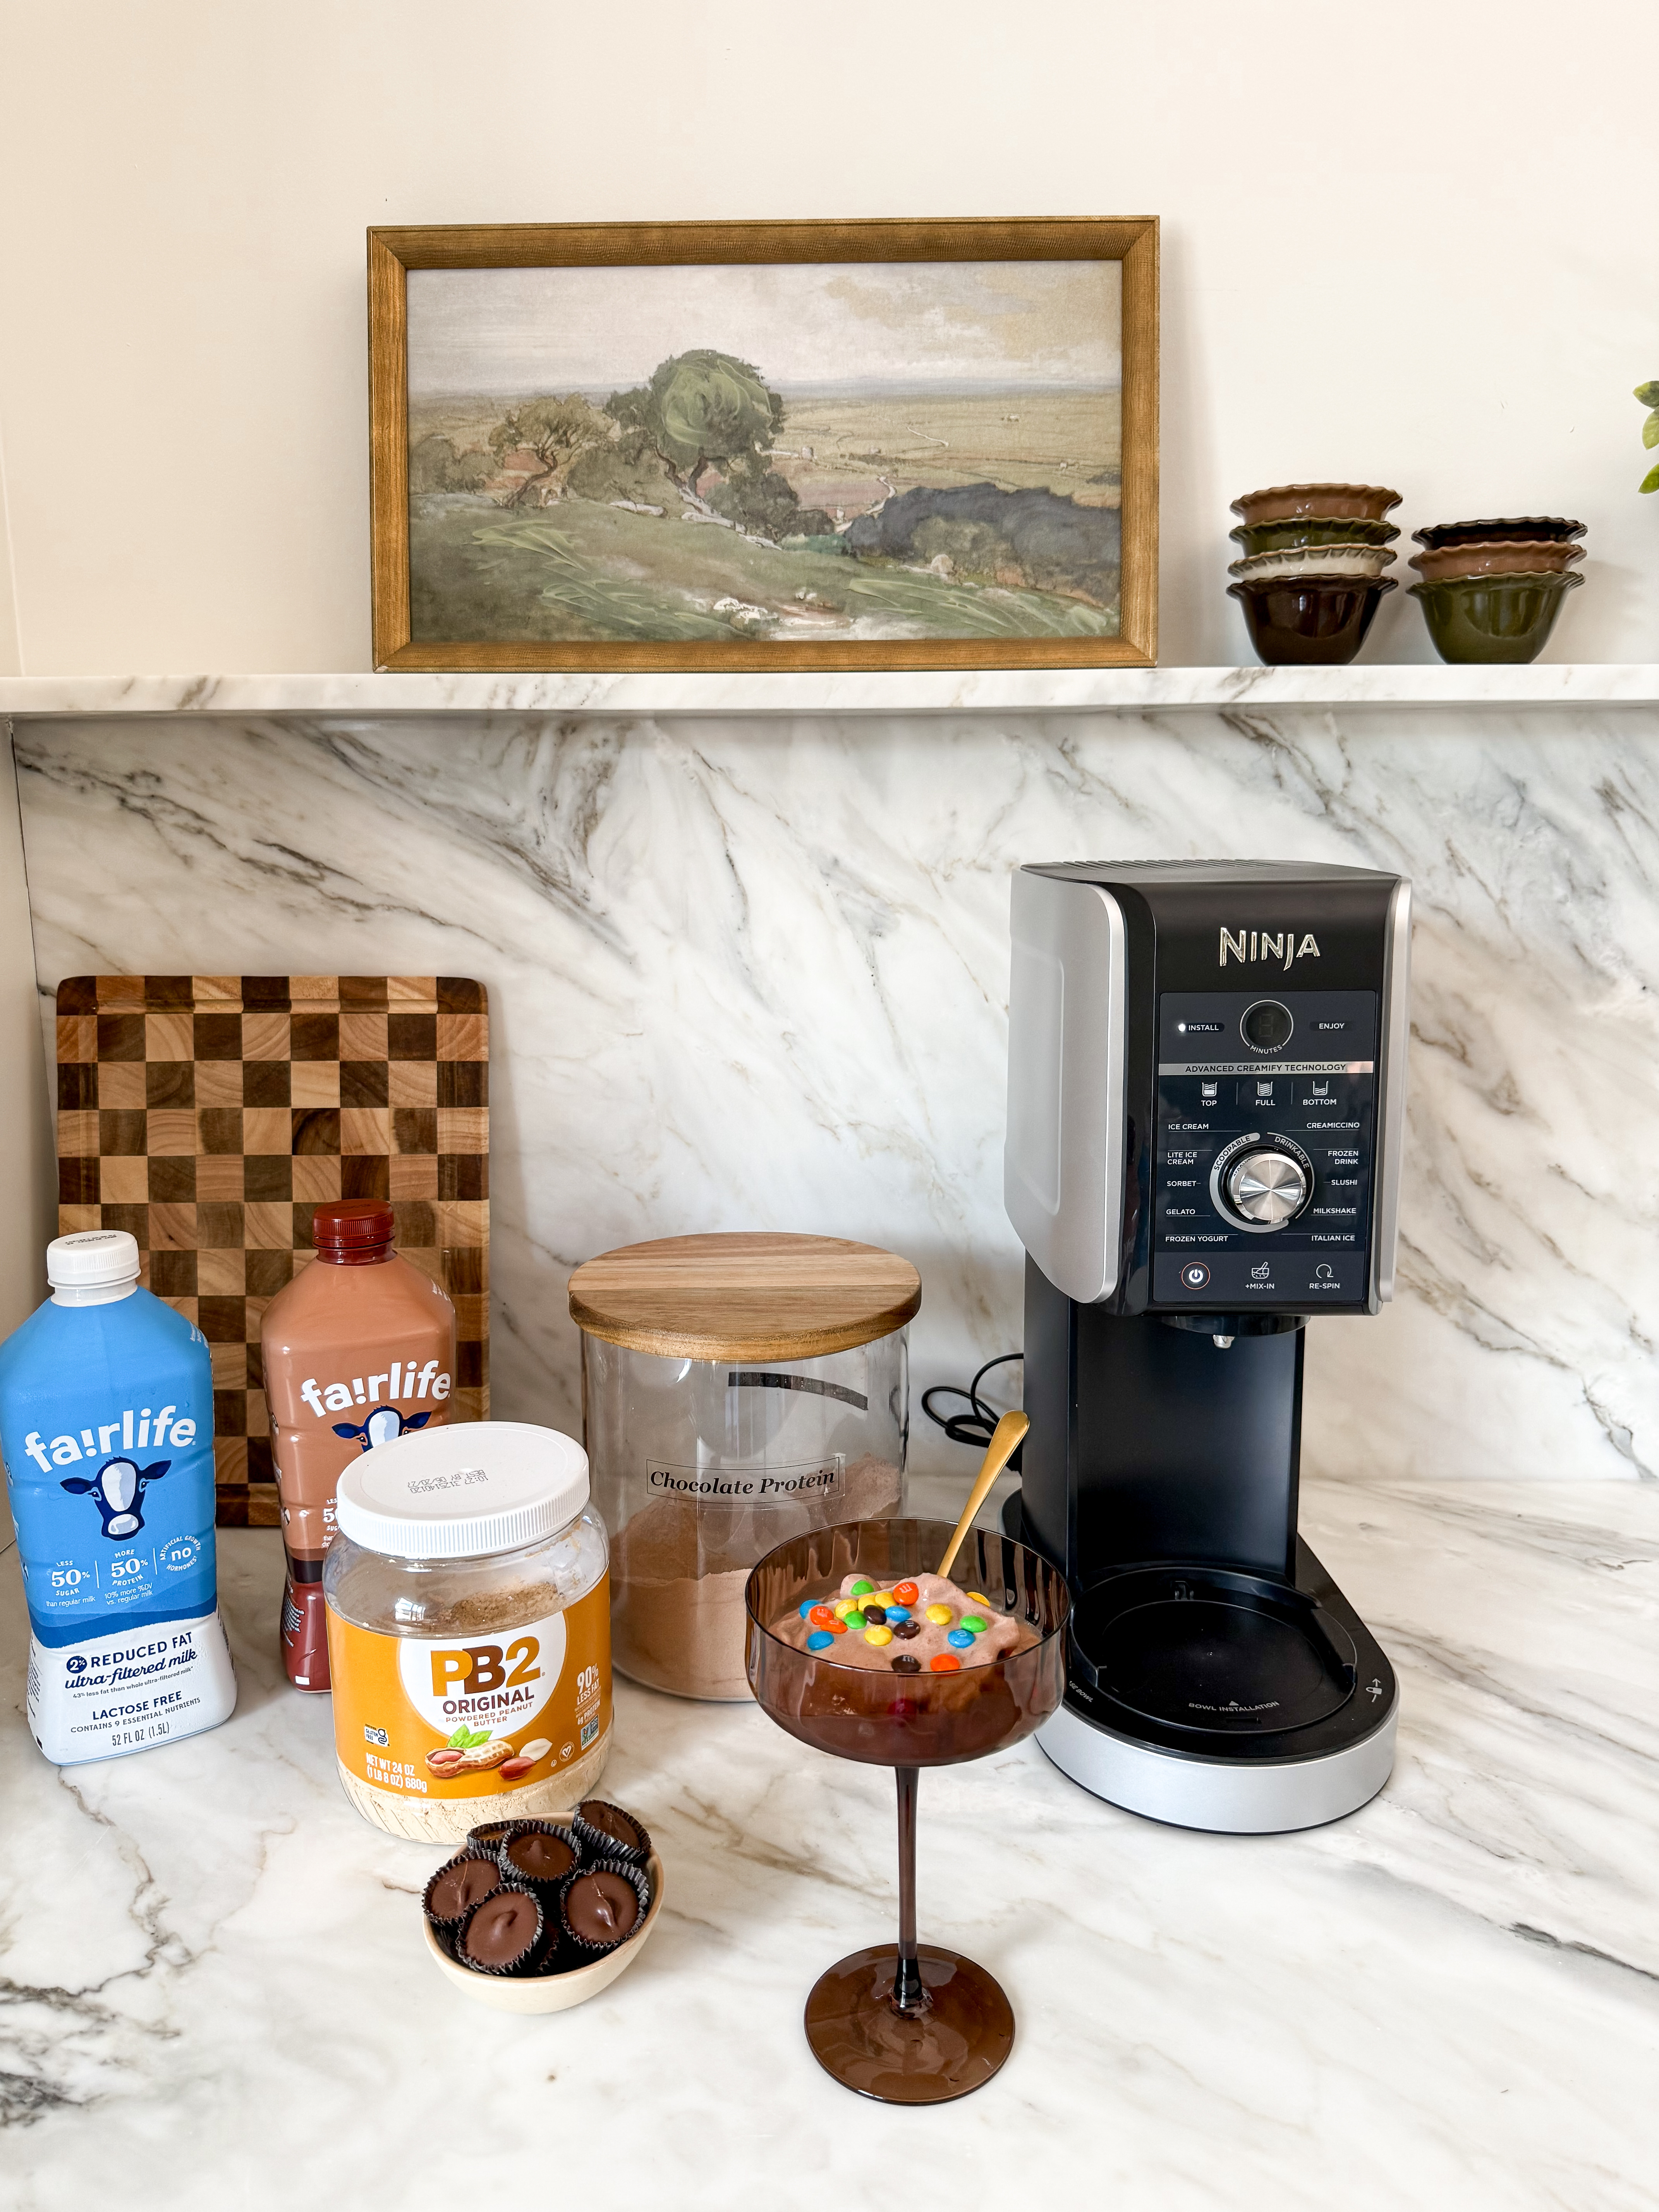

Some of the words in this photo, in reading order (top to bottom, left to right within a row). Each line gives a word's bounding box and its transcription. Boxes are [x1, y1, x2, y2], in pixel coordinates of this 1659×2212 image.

[1220, 927, 1320, 970] NINJA
[1250, 1045, 1282, 1054] MINUTES
[1285, 1063, 1346, 1072] TECHNOLOGY
[1214, 1135, 1251, 1171] SCOOPABLE
[1274, 1136, 1310, 1169] DRINKABLE
[408, 1476, 447, 1488] 06/20/27
[466, 1470, 486, 1478] BEST
[650, 1470, 754, 1494] Chocolate
[758, 1469, 835, 1494] Protein
[115, 1549, 135, 1558] MORE
[160, 1536, 183, 1561] ARTIFICIAL
[185, 1535, 201, 1551] GROWTH
[172, 1547, 192, 1561] no
[52, 1569, 91, 1587] 50%
[111, 1558, 148, 1577] 50%
[105, 1591, 118, 1599] 10%
[120, 1588, 137, 1596] more
[138, 1582, 152, 1592] %DV
[112, 1574, 144, 1586] PROTEIN
[59, 1599, 81, 1607] regular
[118, 1594, 140, 1603] regular
[70, 1656, 86, 1671] 2%
[91, 1641, 167, 1668] REDUCED
[173, 1632, 192, 1649] FAT
[65, 1658, 167, 1689] ultra-filtered
[168, 1648, 198, 1668] milk
[430, 1636, 541, 1696] PB2
[577, 1663, 599, 1694] 90%
[93, 1701, 149, 1720] LACTOSE
[153, 1691, 182, 1708] FREE
[443, 1686, 534, 1714] ORIGINAL
[577, 1687, 591, 1705] LESS
[1076, 1689, 1093, 1702] BOWL
[1188, 1702, 1217, 1711] BOWL
[1219, 1701, 1280, 1711] INSTALLATION
[70, 1722, 112, 1733] CONTAINS
[123, 1711, 163, 1725] ESSENTIAL
[165, 1697, 201, 1714] NUTRIENTS
[446, 1712, 496, 1723] POWDERED
[500, 1702, 533, 1717] PEANUT
[474, 1716, 507, 1727] BUTTER
[577, 1716, 584, 1724] 6g
[584, 1698, 600, 1719] PROTEIN
[112, 1734, 122, 1746] 52
[124, 1732, 133, 1743] FL
[135, 1729, 145, 1741] OZ
[149, 1721, 169, 1739] (1.5L)
[366, 1752, 378, 1767] NET
[379, 1758, 391, 1771] WT
[392, 1761, 403, 1774] 24
[404, 1764, 415, 1776] OZ
[367, 1764, 373, 1778] (1
[374, 1768, 383, 1781] LB
[383, 1772, 389, 1783] 8
[390, 1774, 404, 1788] OZ)
[405, 1777, 428, 1793] 680g
